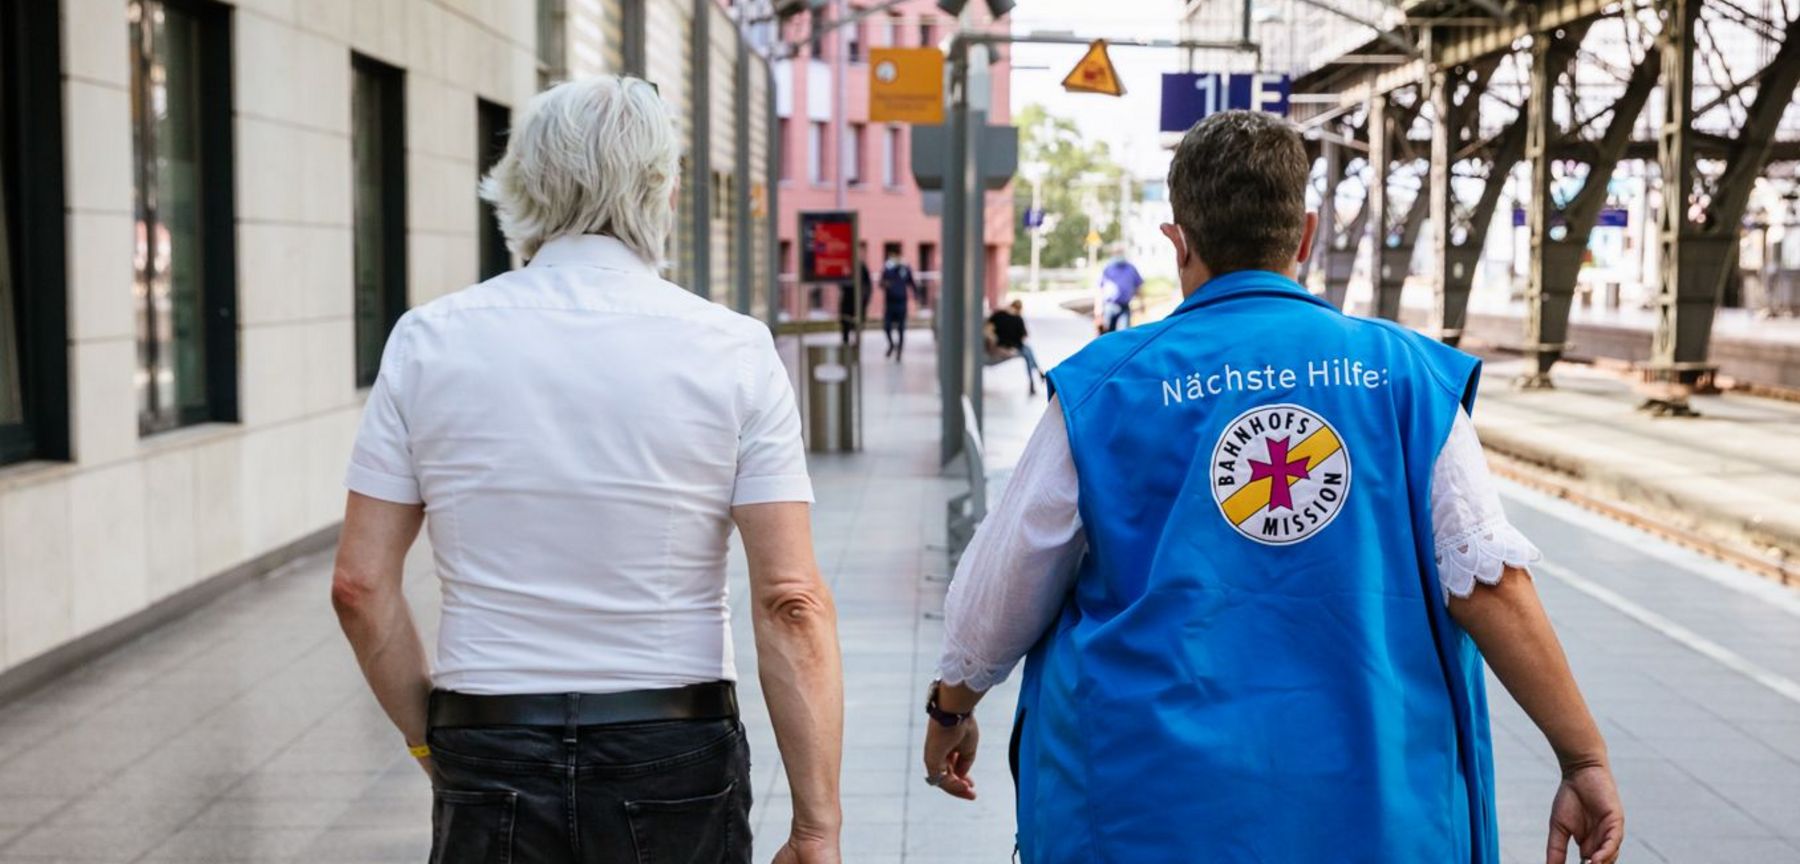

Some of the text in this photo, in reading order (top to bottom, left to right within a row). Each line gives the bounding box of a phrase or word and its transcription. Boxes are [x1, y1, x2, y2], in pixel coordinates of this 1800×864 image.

[1195, 73, 1217, 118] 1
[1250, 73, 1284, 118] E
[1162, 357, 1388, 406] Nächste Hilfe:
[1218, 412, 1310, 487] BAHNHOFS
[1262, 472, 1343, 537] MISSION
